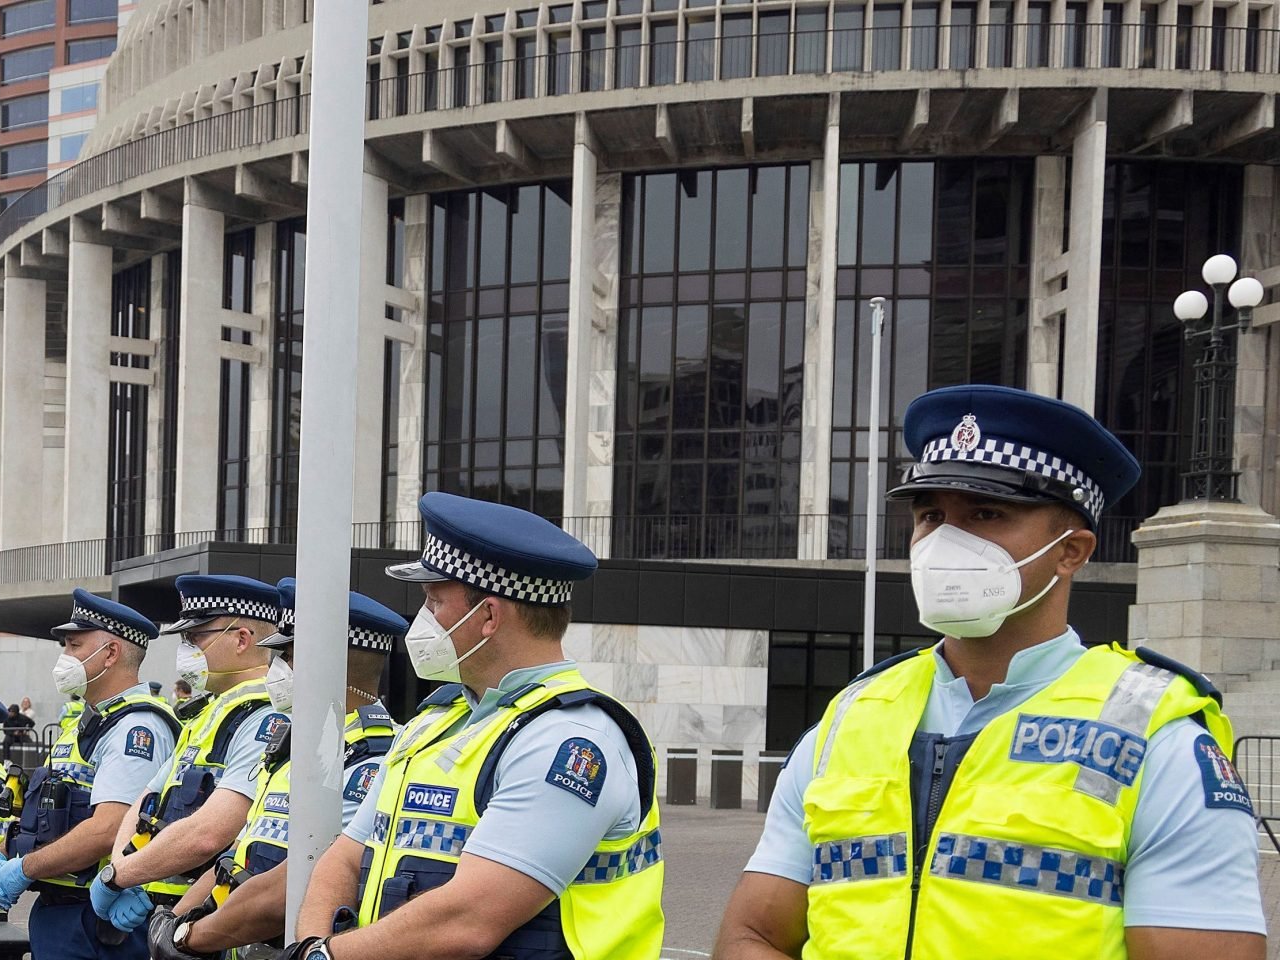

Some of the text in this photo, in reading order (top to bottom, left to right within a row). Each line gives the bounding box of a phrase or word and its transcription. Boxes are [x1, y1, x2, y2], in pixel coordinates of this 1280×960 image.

[983, 587, 1006, 597] KN95
[128, 748, 150, 757] POLICE
[1014, 722, 1144, 778] POLICE
[553, 773, 593, 799] POLICE
[407, 790, 452, 808] POLICE
